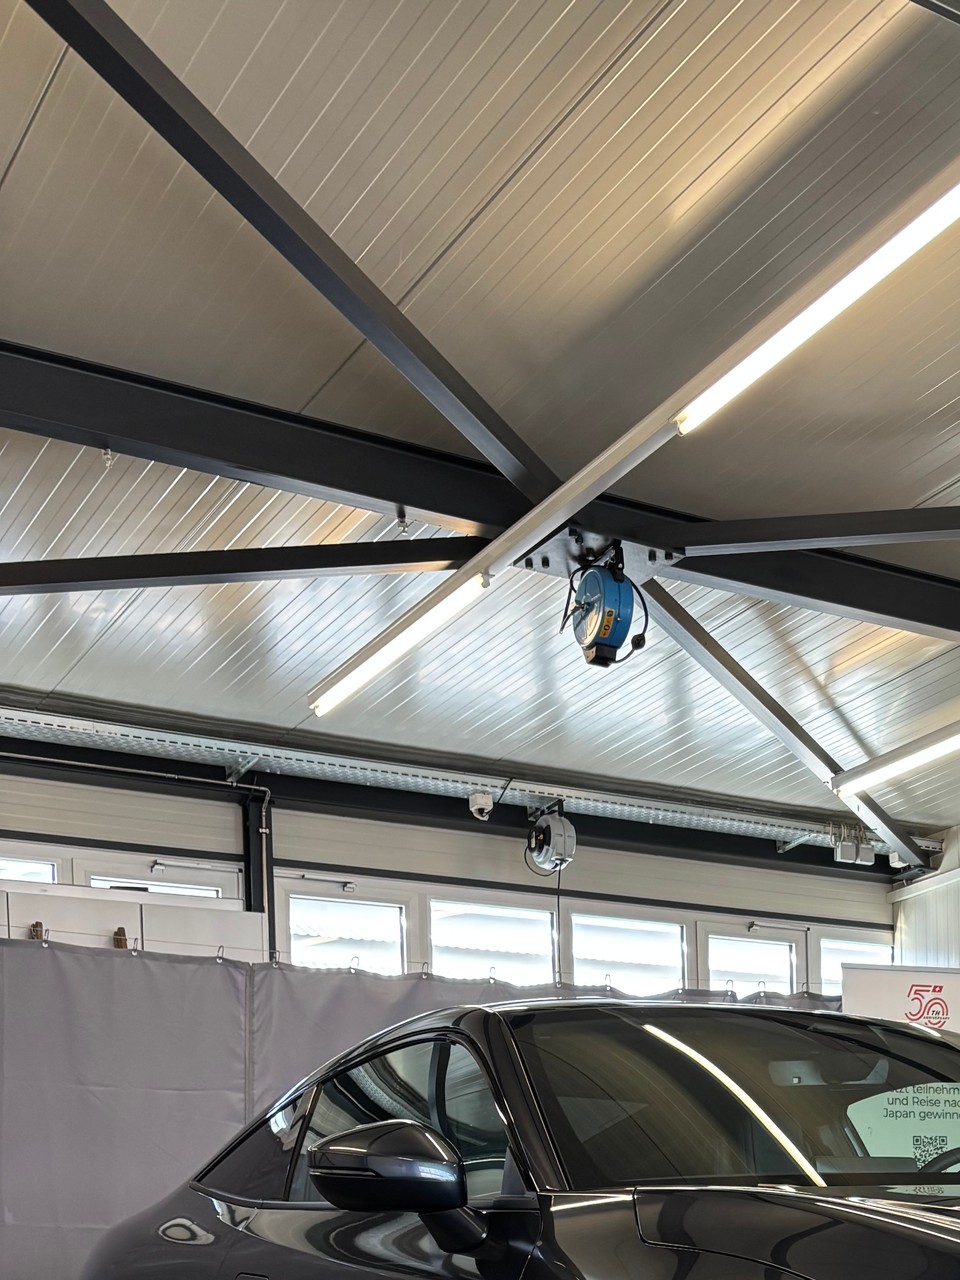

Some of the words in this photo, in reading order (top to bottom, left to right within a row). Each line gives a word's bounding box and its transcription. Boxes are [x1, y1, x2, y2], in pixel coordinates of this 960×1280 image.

[905, 984, 949, 1028] 50
[887, 1096, 908, 1106] und
[912, 1096, 940, 1107] Reise
[883, 1108, 915, 1120] Japan
